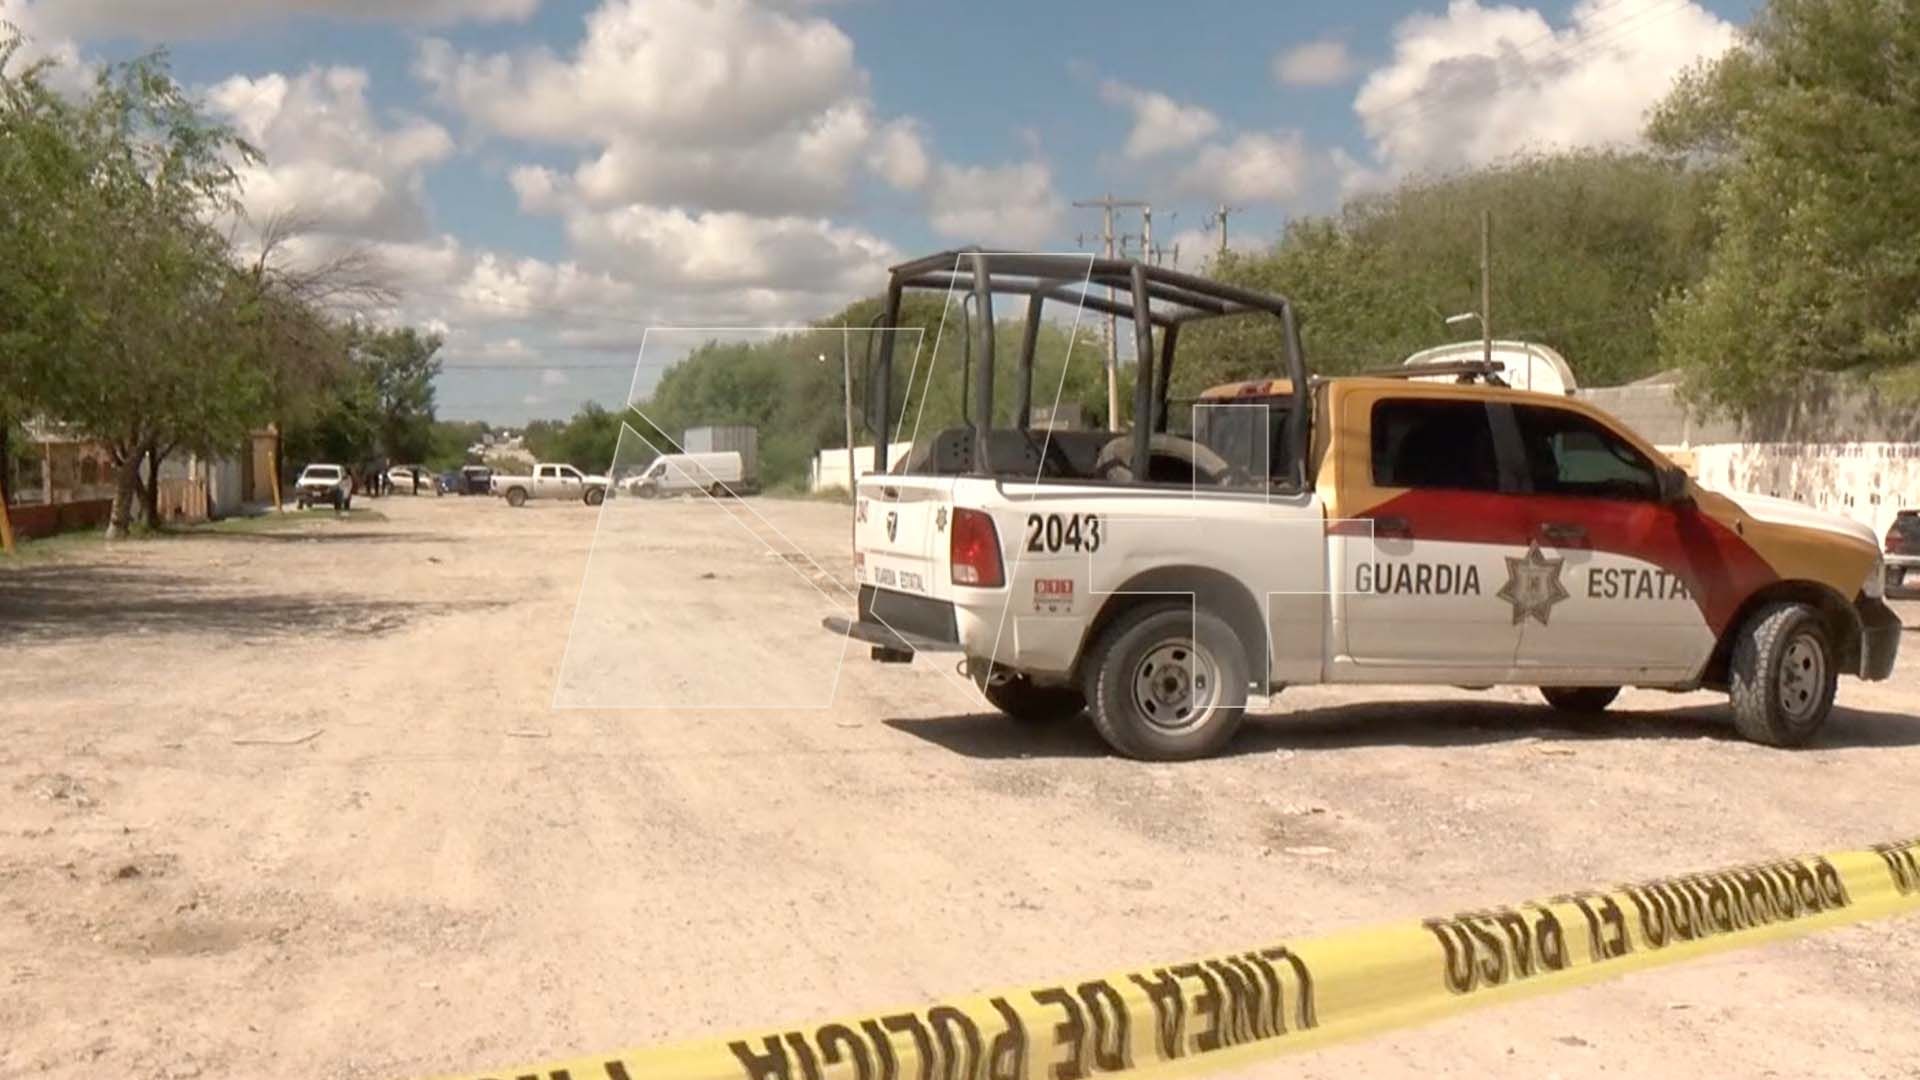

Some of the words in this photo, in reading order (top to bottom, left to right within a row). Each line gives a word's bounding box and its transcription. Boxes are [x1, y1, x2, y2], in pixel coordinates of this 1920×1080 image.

[1027, 514, 1101, 552] 2043
[1355, 562, 1481, 596] GUARDIA
[1587, 568, 1697, 600] ESTATA
[1552, 896, 1633, 963] EL
[1615, 856, 1851, 950] PROHIBIDO
[1422, 902, 1568, 995] PASO
[728, 998, 1029, 1080] POLICIA
[1031, 980, 1134, 1080] DE
[1127, 948, 1318, 1062] LINEA
